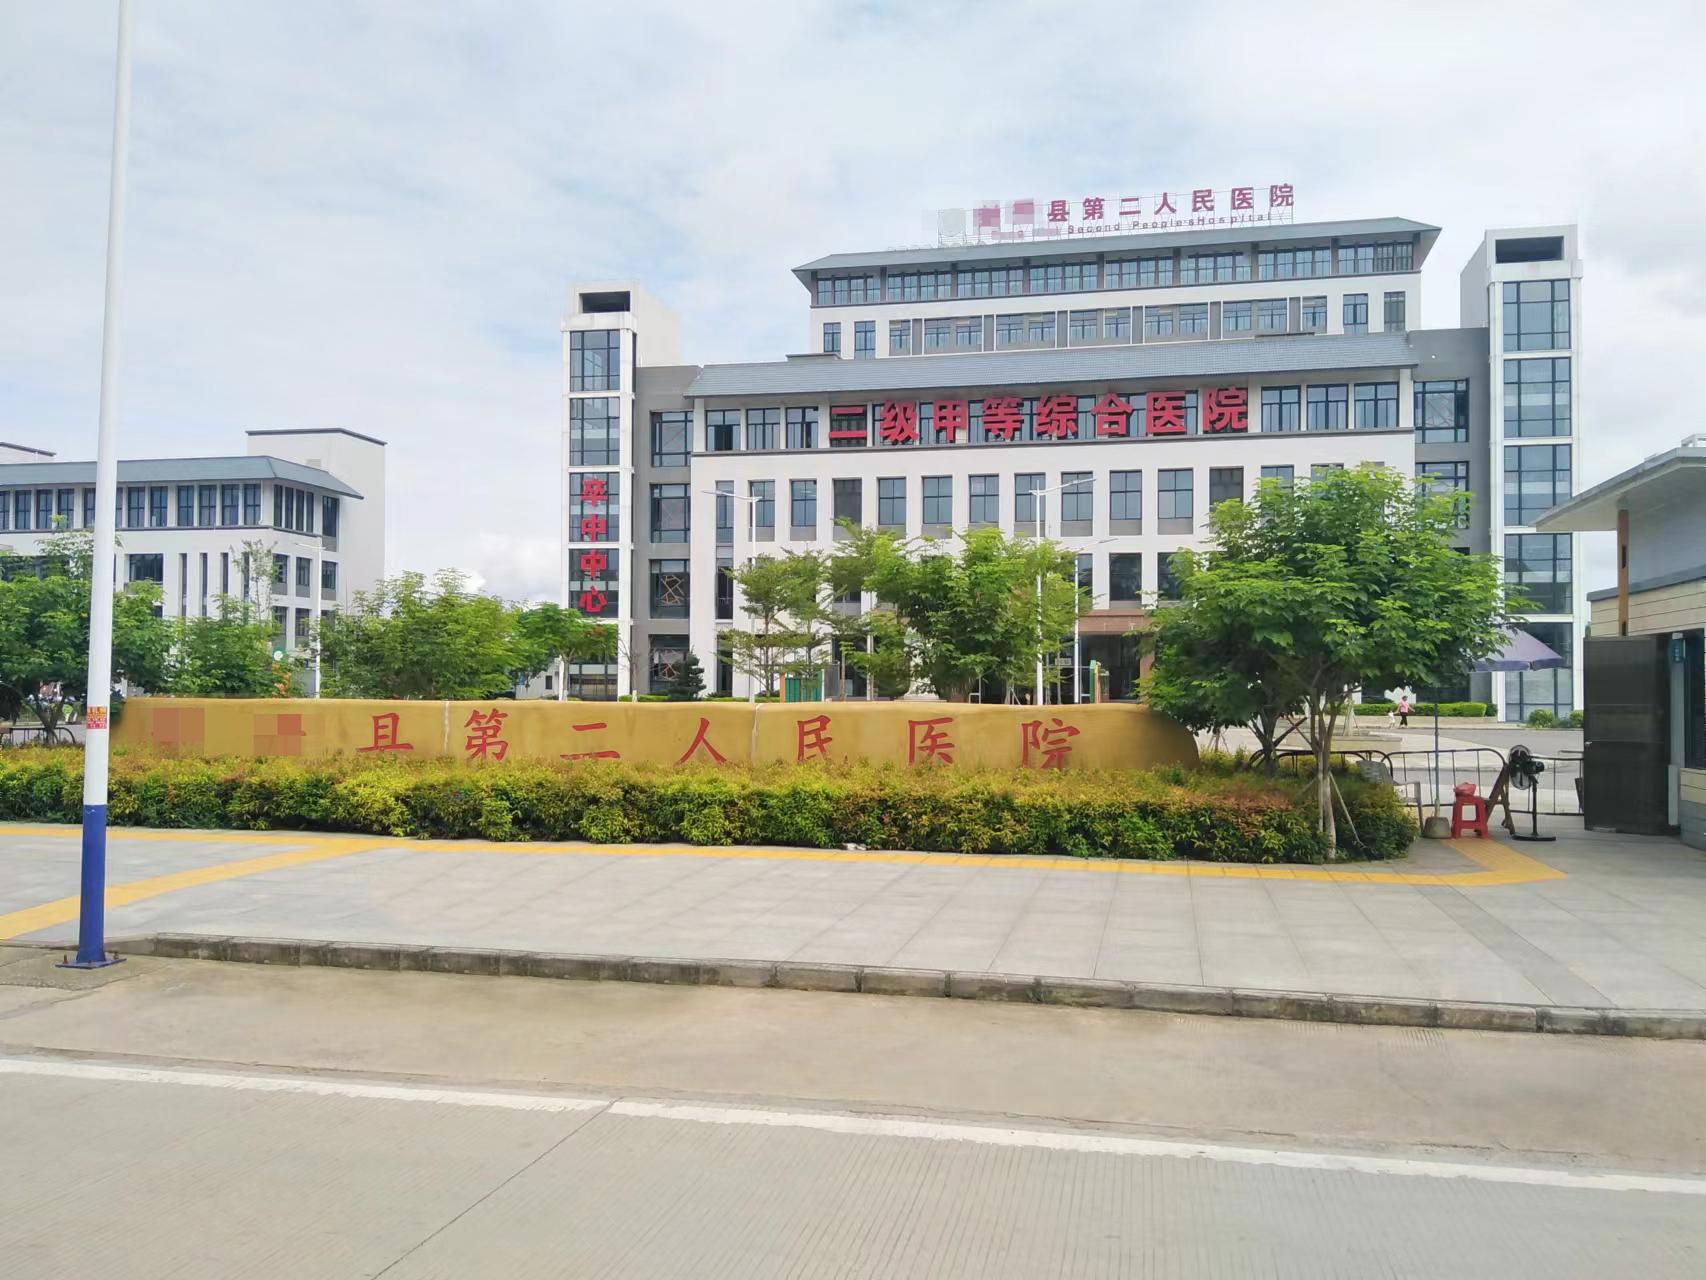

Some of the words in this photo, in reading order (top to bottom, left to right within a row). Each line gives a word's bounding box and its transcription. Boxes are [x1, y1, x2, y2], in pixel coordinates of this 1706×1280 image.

[1047, 183, 1294, 222] 县第二人民医院
[1067, 222, 1120, 235] Second
[829, 386, 1248, 442] 二级甲等综合医院
[579, 475, 608, 613] 卒中中心
